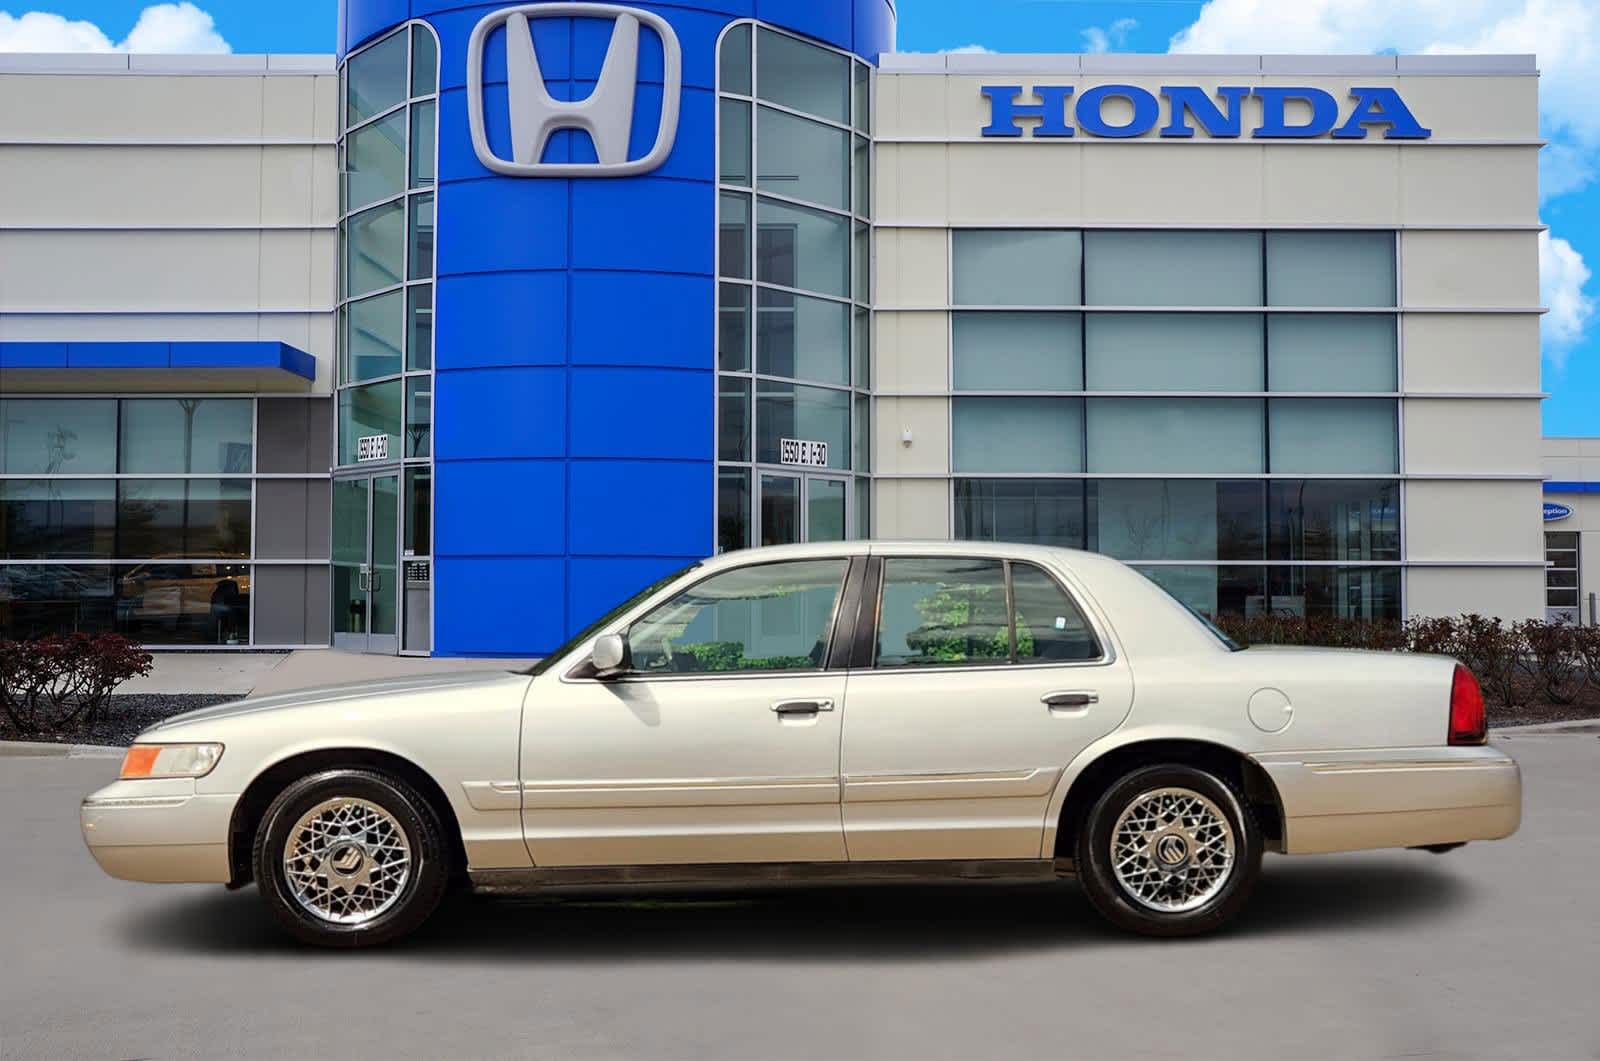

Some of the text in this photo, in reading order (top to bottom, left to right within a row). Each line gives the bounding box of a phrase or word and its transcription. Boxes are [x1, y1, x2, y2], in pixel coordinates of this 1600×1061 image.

[981, 85, 1431, 139] HONDA
[782, 440, 800, 463] 1550
[810, 443, 826, 465] I-30
